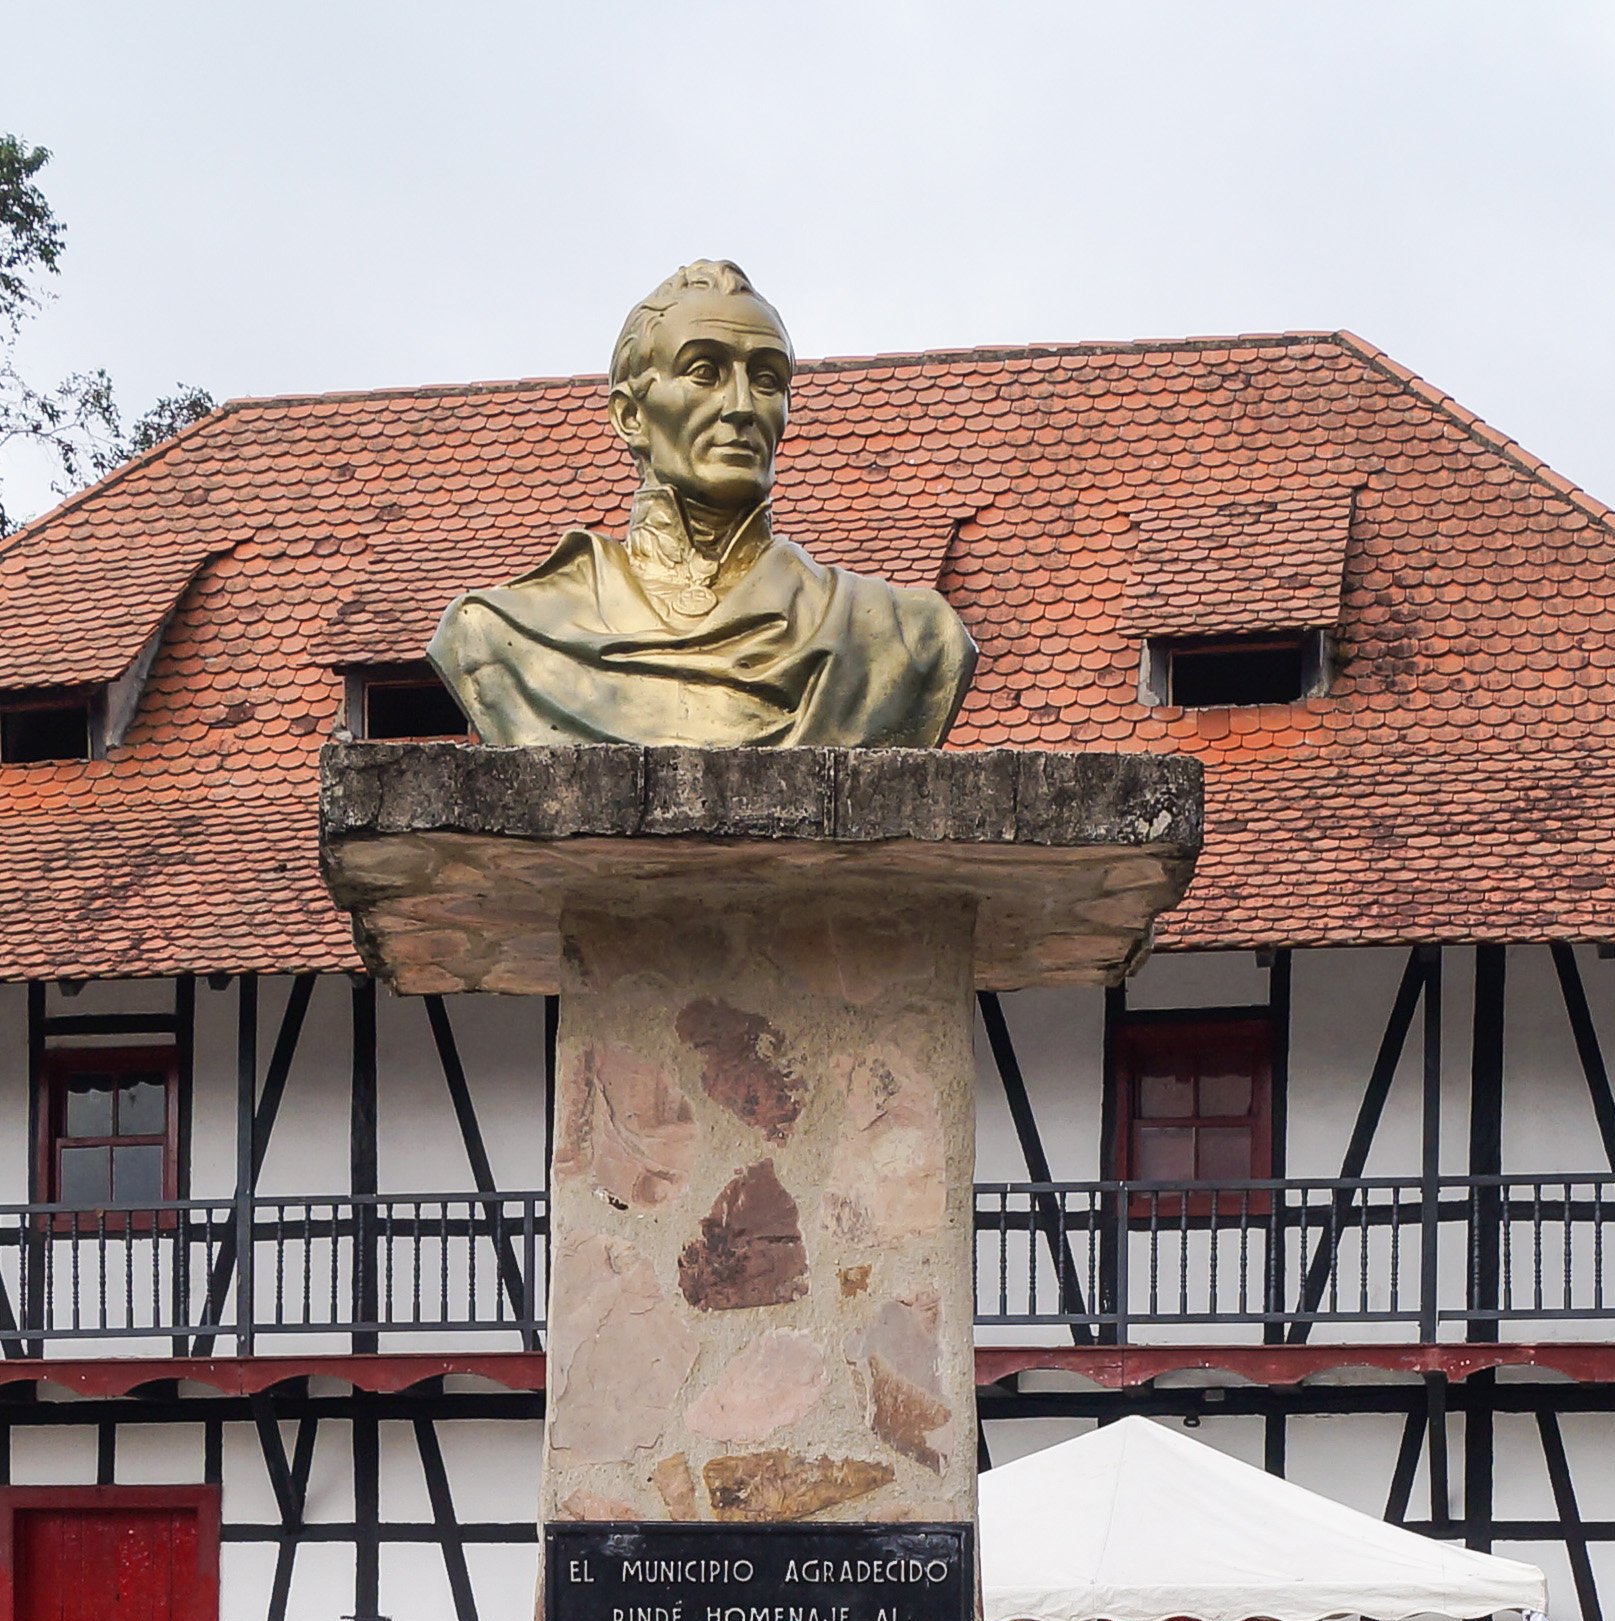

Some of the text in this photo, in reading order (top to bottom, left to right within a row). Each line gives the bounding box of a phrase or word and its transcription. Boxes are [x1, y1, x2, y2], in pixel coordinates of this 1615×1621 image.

[570, 1560, 948, 1583] EL MUNICIPIO AGRADECIDO
